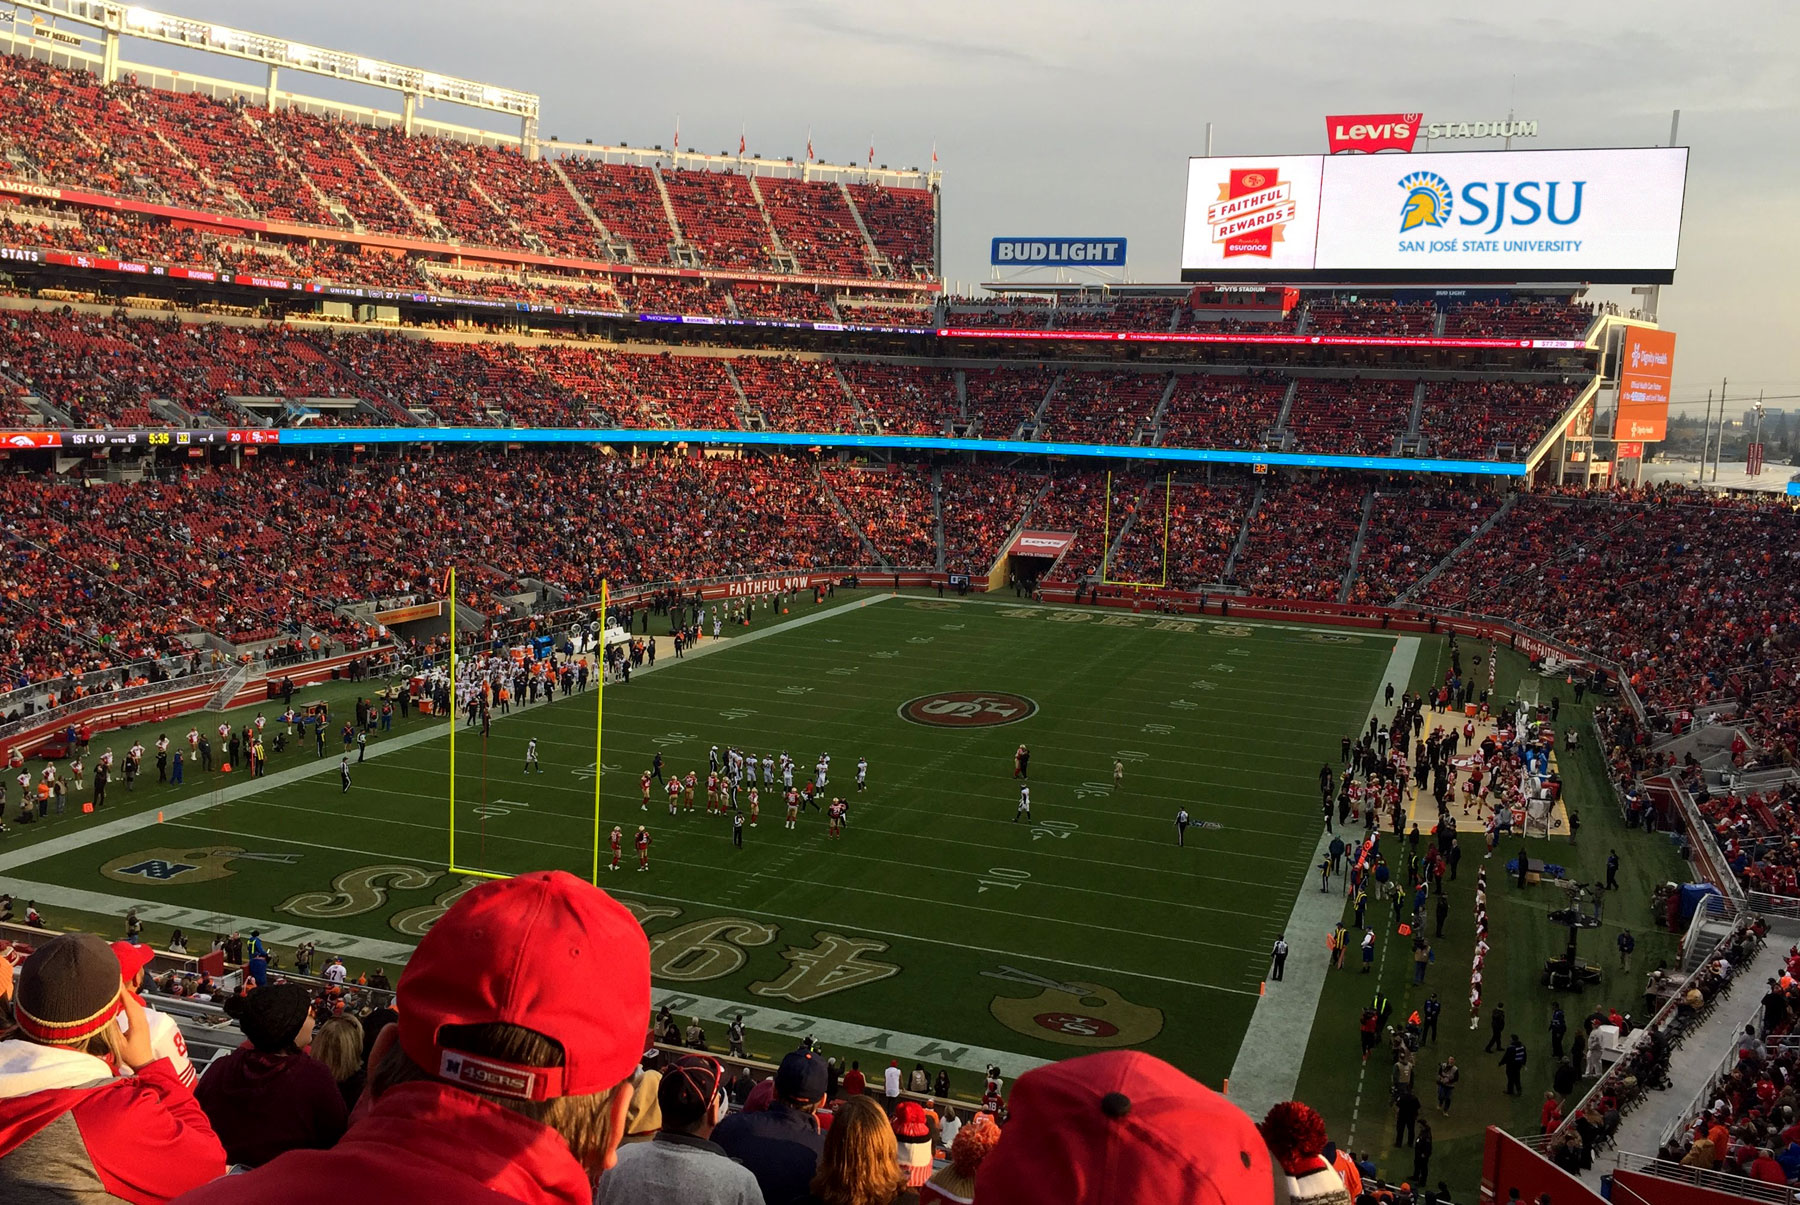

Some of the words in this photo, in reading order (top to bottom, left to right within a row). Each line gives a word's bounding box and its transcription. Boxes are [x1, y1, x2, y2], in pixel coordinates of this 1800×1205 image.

[1427, 120, 1538, 139] STADIUM
[1221, 190, 1283, 215] FAITHFUL
[1459, 181, 1587, 235] SJSU
[1220, 210, 1283, 236] REWARDS
[998, 243, 1047, 260] BUD
[1049, 243, 1118, 261] LIGHT
[1399, 241, 1424, 252] SAN
[1428, 238, 1458, 254] JOSÉ
[1462, 241, 1499, 252] STATE
[1503, 241, 1582, 252] UNIVERSITY
[1, 247, 38, 262] STATS
[118, 262, 146, 272] PASSING
[188, 270, 214, 280] RUSHING
[252, 277, 269, 287] TOTAL
[269, 279, 288, 289] YARDS
[47, 435, 53, 444] 7
[73, 434, 87, 444] 1ST
[95, 434, 105, 444] 10
[128, 434, 136, 443] 15
[149, 432, 169, 444] 5:35
[180, 433, 187, 441] 32
[209, 433, 214, 441] 4
[231, 433, 241, 442] 20
[1256, 464, 1266, 472] 32
[729, 580, 780, 597] FAITHFUL
[784, 576, 808, 591] NOW
[995, 608, 1254, 638] 49ERS
[1030, 820, 1079, 840] 20
[977, 866, 1031, 890] 10
[331, 970, 338, 980] 7
[464, 1066, 526, 1089] 49ERS
[988, 1101, 997, 1111] 18
